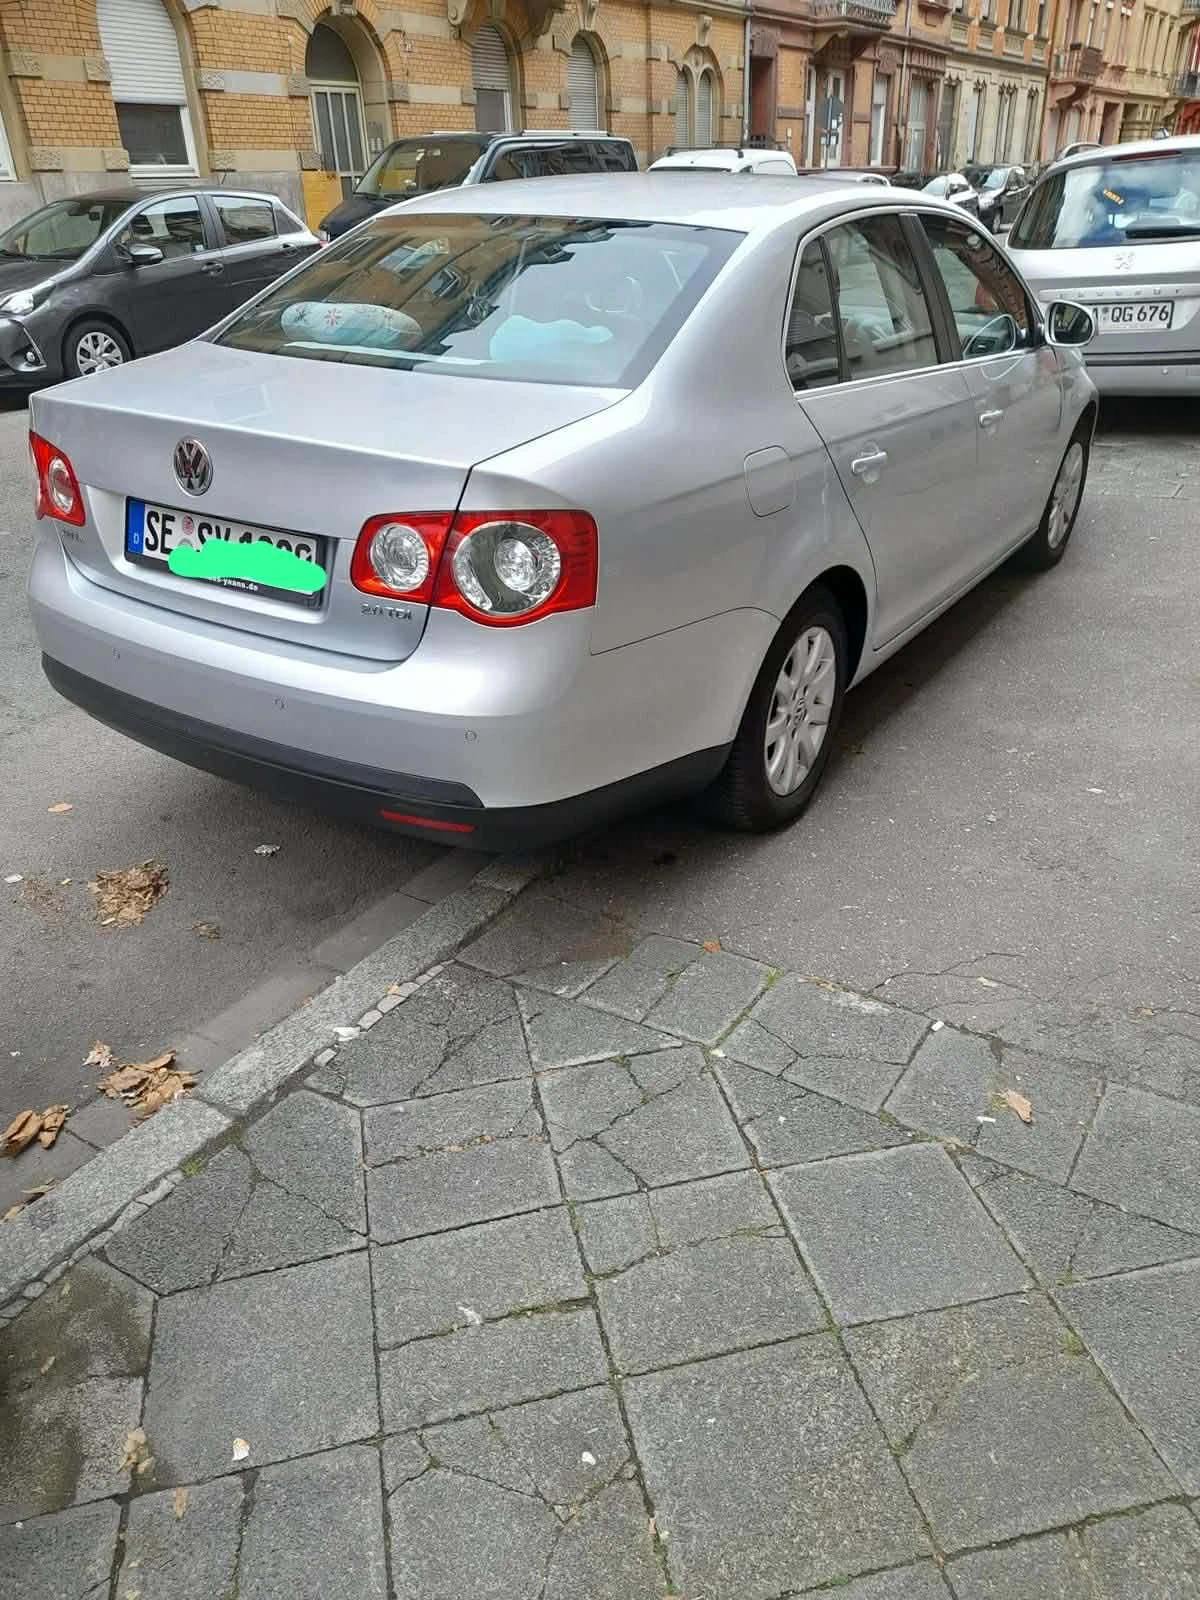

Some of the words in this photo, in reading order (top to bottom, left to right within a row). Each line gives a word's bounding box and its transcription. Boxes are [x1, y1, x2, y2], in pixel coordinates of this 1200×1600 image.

[1111, 307, 1133, 322] QG
[1137, 305, 1169, 321] 676
[133, 532, 140, 545] D
[145, 511, 176, 554] SE
